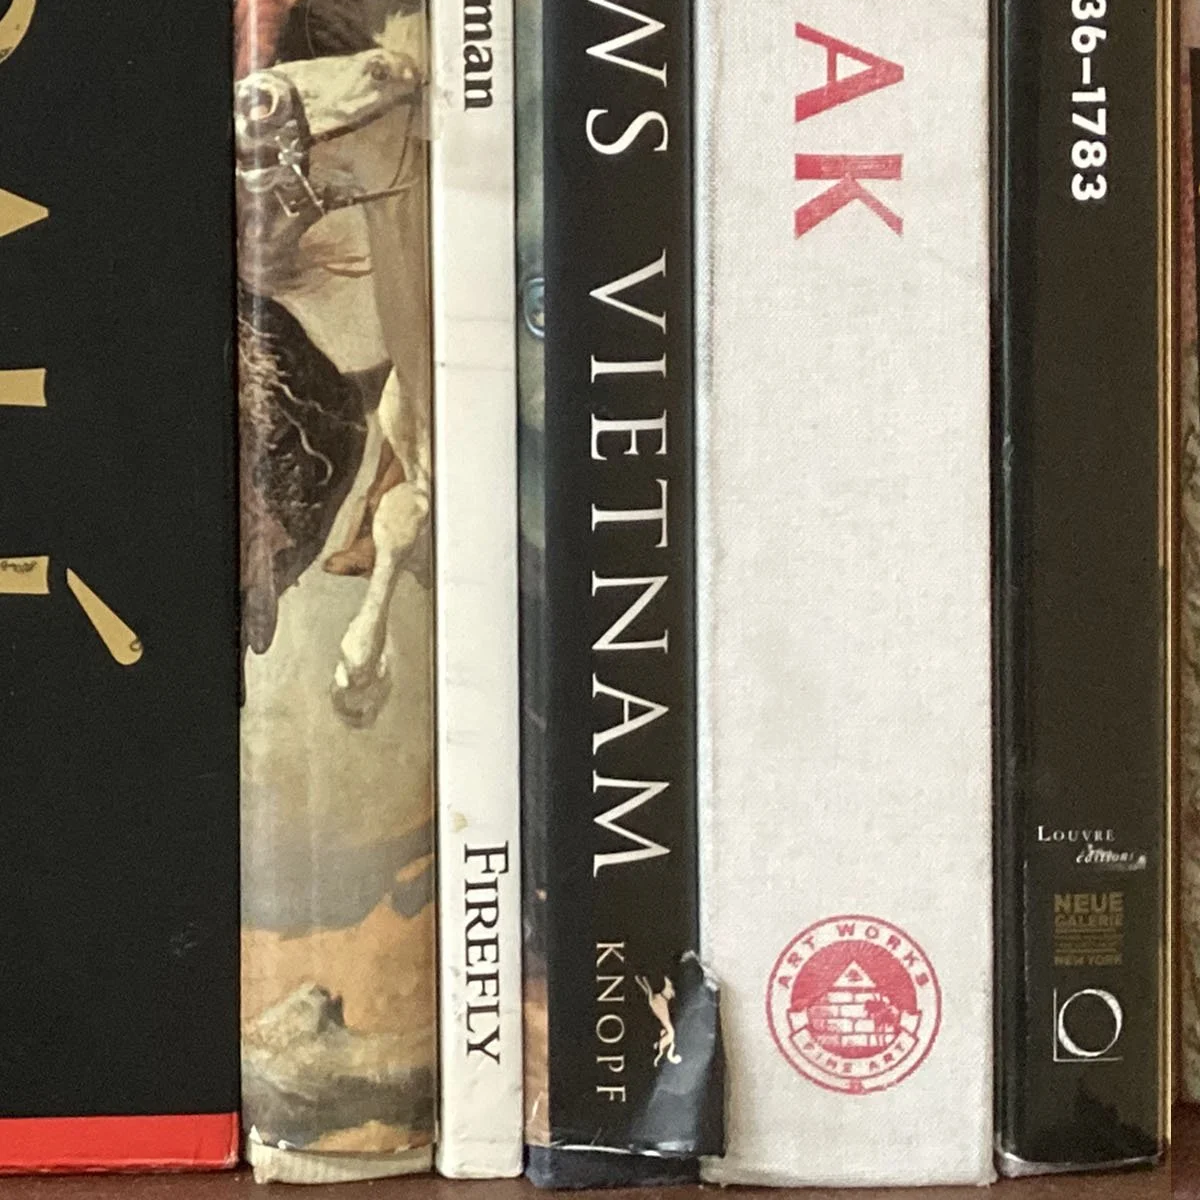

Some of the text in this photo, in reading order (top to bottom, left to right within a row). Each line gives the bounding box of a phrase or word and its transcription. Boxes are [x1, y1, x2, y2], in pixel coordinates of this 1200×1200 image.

[588, 248, 672, 879] VIETNAM
[1037, 824, 1116, 842] LOUVRE
[463, 840, 510, 1066] FIREFLY
[777, 922, 931, 989] ART WORKS
[1053, 891, 1124, 913] NEUE
[595, 941, 627, 1103] KNOPF
